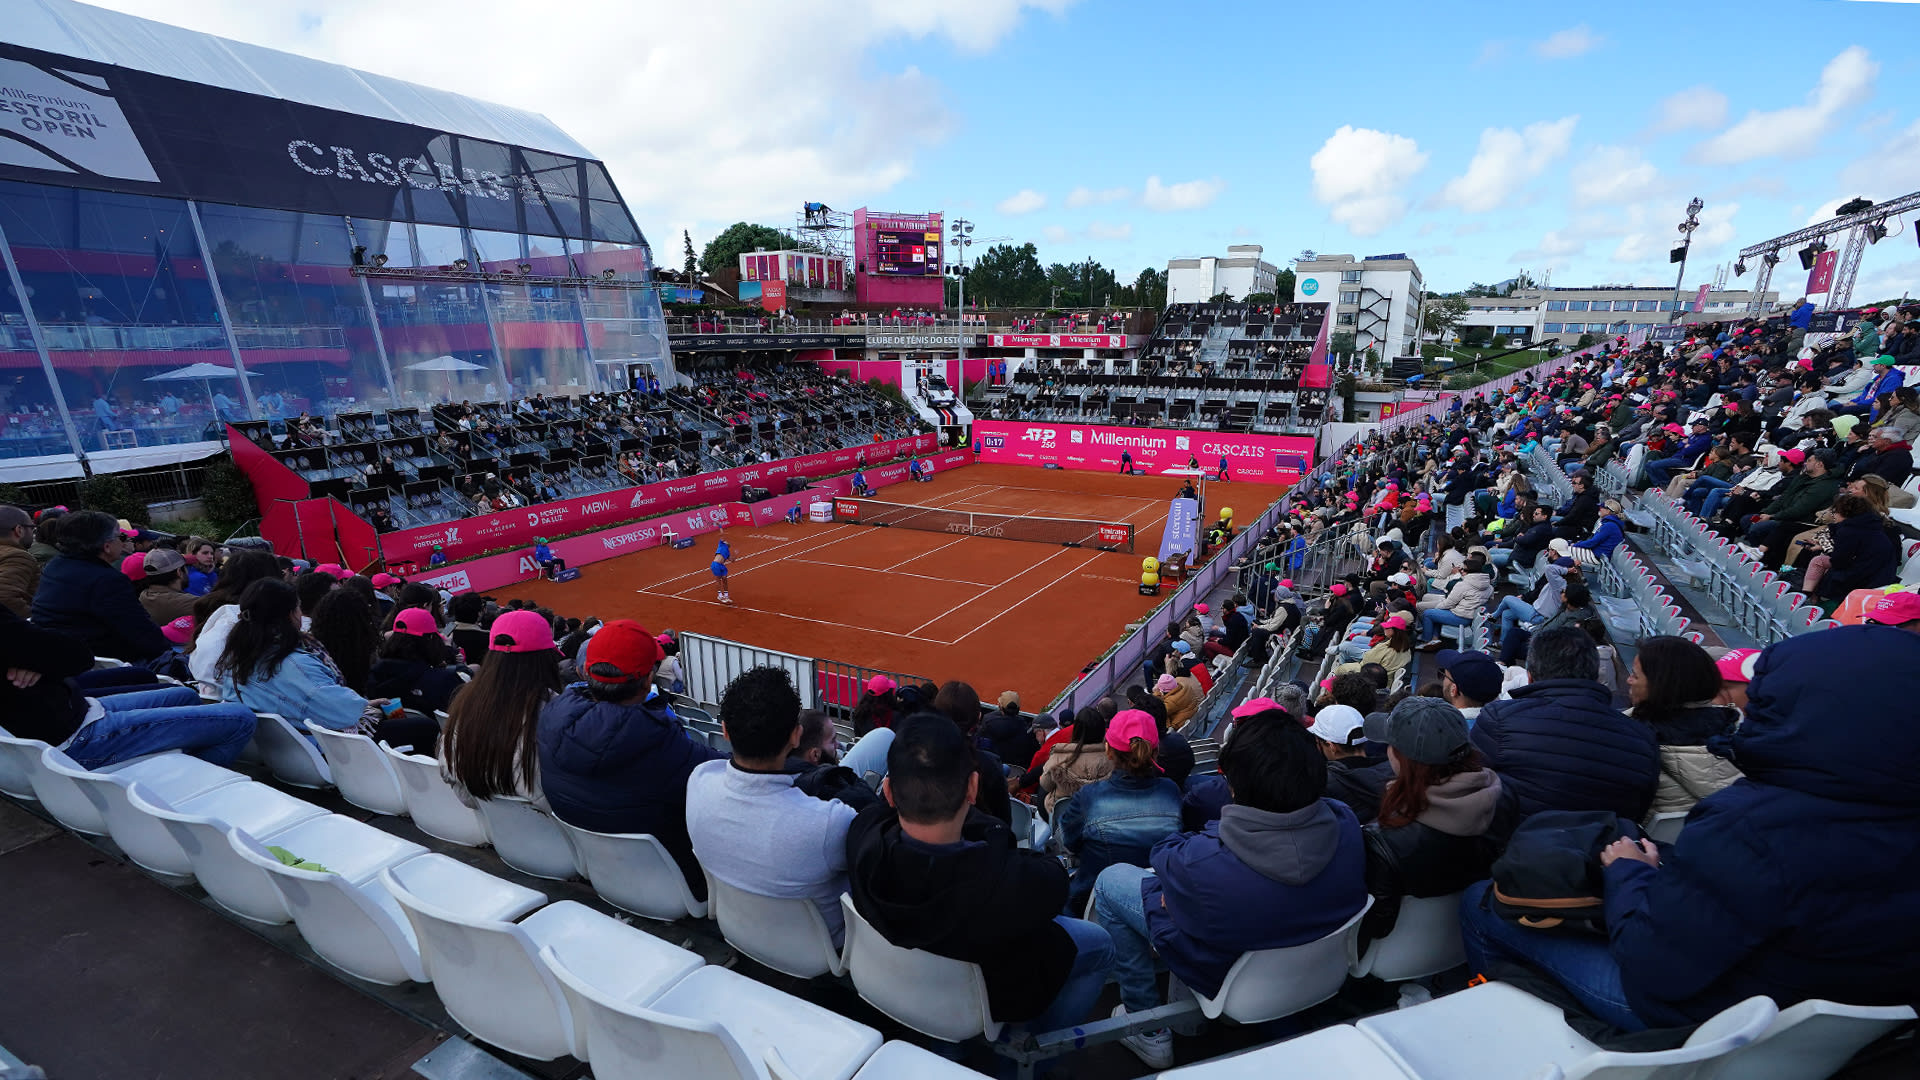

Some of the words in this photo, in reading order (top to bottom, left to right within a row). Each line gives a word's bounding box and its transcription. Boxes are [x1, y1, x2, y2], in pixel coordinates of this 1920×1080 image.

[0, 87, 91, 111] Millennium
[21, 116, 97, 140] OPEN
[287, 140, 510, 202] CASCAIS
[866, 336, 893, 346] CLUBE
[894, 336, 904, 346] DE
[905, 334, 929, 346] TÉNIS
[931, 336, 943, 346] DO
[986, 437, 1003, 446] 0:17
[1021, 428, 1057, 442] ATP
[1090, 428, 1167, 449] Millennium
[1041, 441, 1056, 449] 250
[1202, 443, 1266, 458] CASCAIS
[1141, 447, 1158, 458] bcp
[540, 505, 569, 518] HOSPITAL
[581, 500, 611, 516] MBW
[541, 516, 550, 524] DA
[551, 514, 564, 523] LUZ
[602, 528, 656, 550] NESPRESSO
[1100, 527, 1127, 537] Emirates
[413, 537, 445, 550] PORTUGAL
[432, 575, 466, 590] etclic
